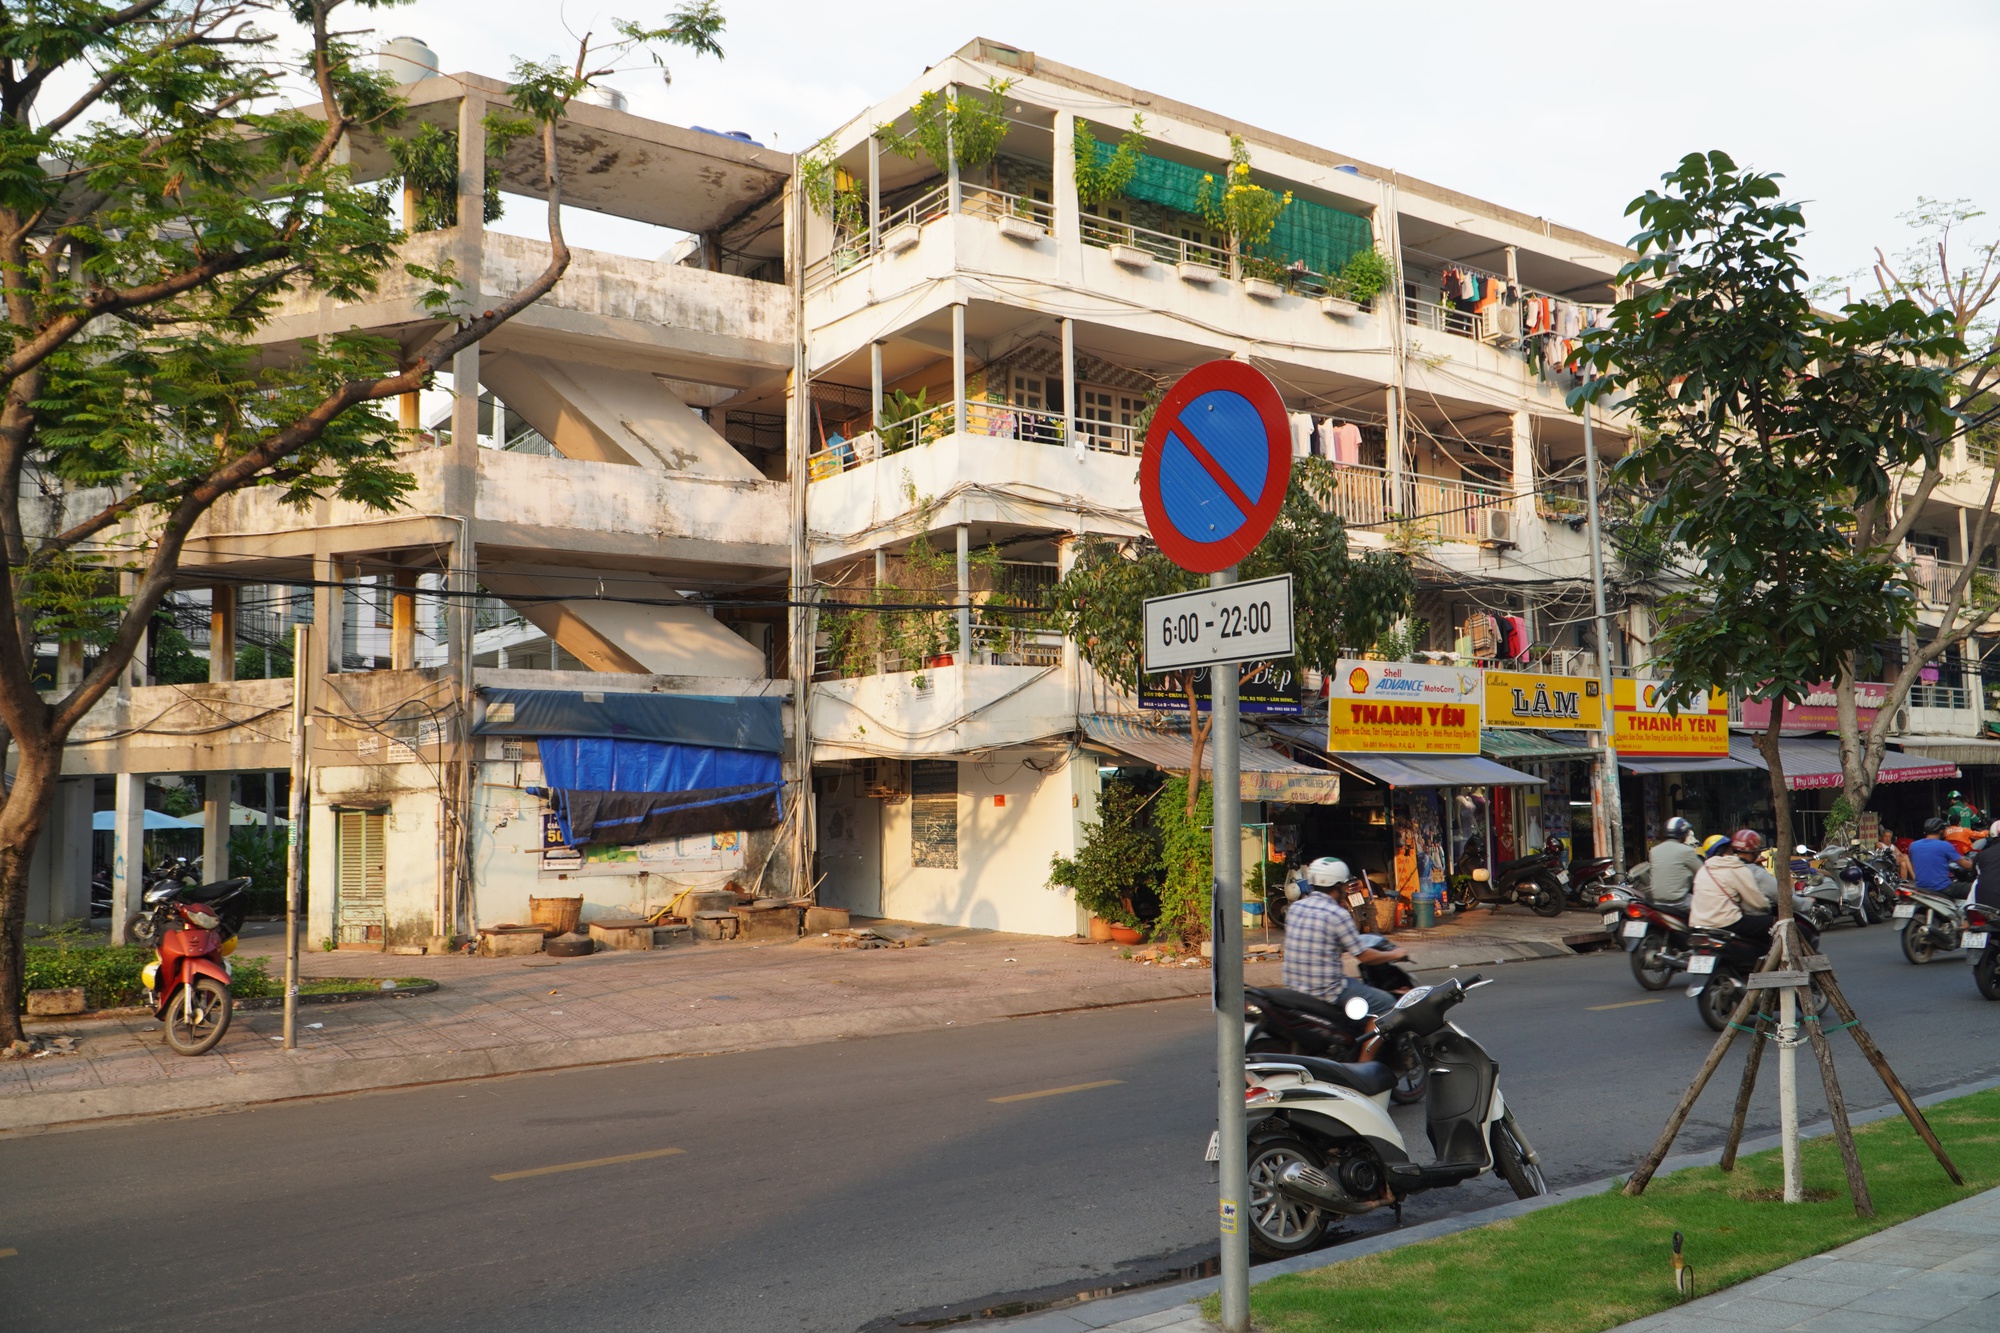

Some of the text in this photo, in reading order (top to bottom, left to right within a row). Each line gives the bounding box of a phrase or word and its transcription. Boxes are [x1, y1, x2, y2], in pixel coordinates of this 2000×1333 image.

[1163, 612, 1198, 646] 6:00
[1220, 601, 1271, 638] 22:00
[1384, 668, 1402, 678] Shell
[1375, 678, 1455, 693] ADVANCE MotoCare
[1351, 704, 1422, 725] THANH
[1628, 716, 1716, 732] THANH YÊN
[1796, 778, 1806, 787] Phụ
[1808, 777, 1818, 786] Liệu
[1819, 776, 1828, 784] Tóc
[1877, 770, 1898, 781] Thảo
